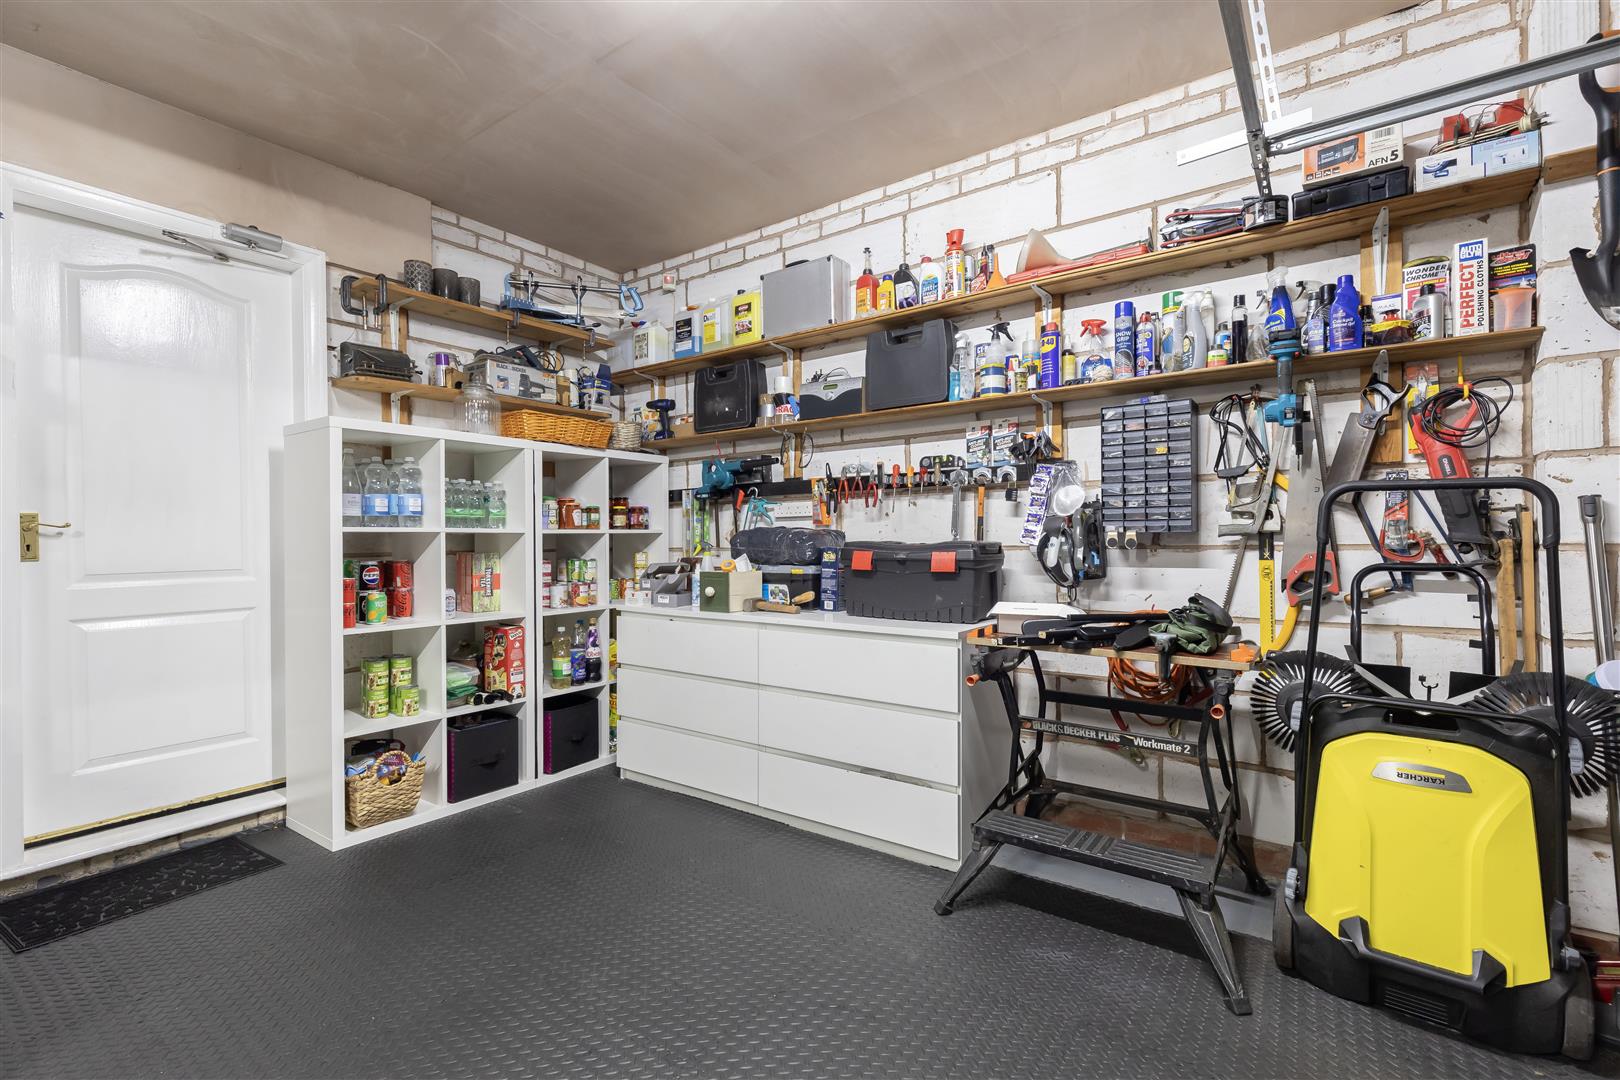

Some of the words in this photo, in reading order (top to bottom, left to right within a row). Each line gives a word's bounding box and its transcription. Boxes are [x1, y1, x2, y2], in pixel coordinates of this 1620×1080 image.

[1367, 156, 1389, 168] AFN
[1389, 149, 1400, 162] 5
[1460, 243, 1483, 254] AUTO
[1460, 250, 1483, 260] GLYM
[1405, 264, 1448, 277] WONDER
[1405, 272, 1440, 283] CHROME
[1476, 259, 1484, 287] CLOTHS
[1459, 263, 1475, 329] PERFECT
[1477, 290, 1485, 327] POLISHING
[1115, 330, 1132, 338] SNOW
[484, 567, 493, 597] YORKSHIRE
[1098, 732, 1121, 743] PLUS
[1133, 736, 1182, 753] Workmate
[1183, 744, 1191, 755] 2
